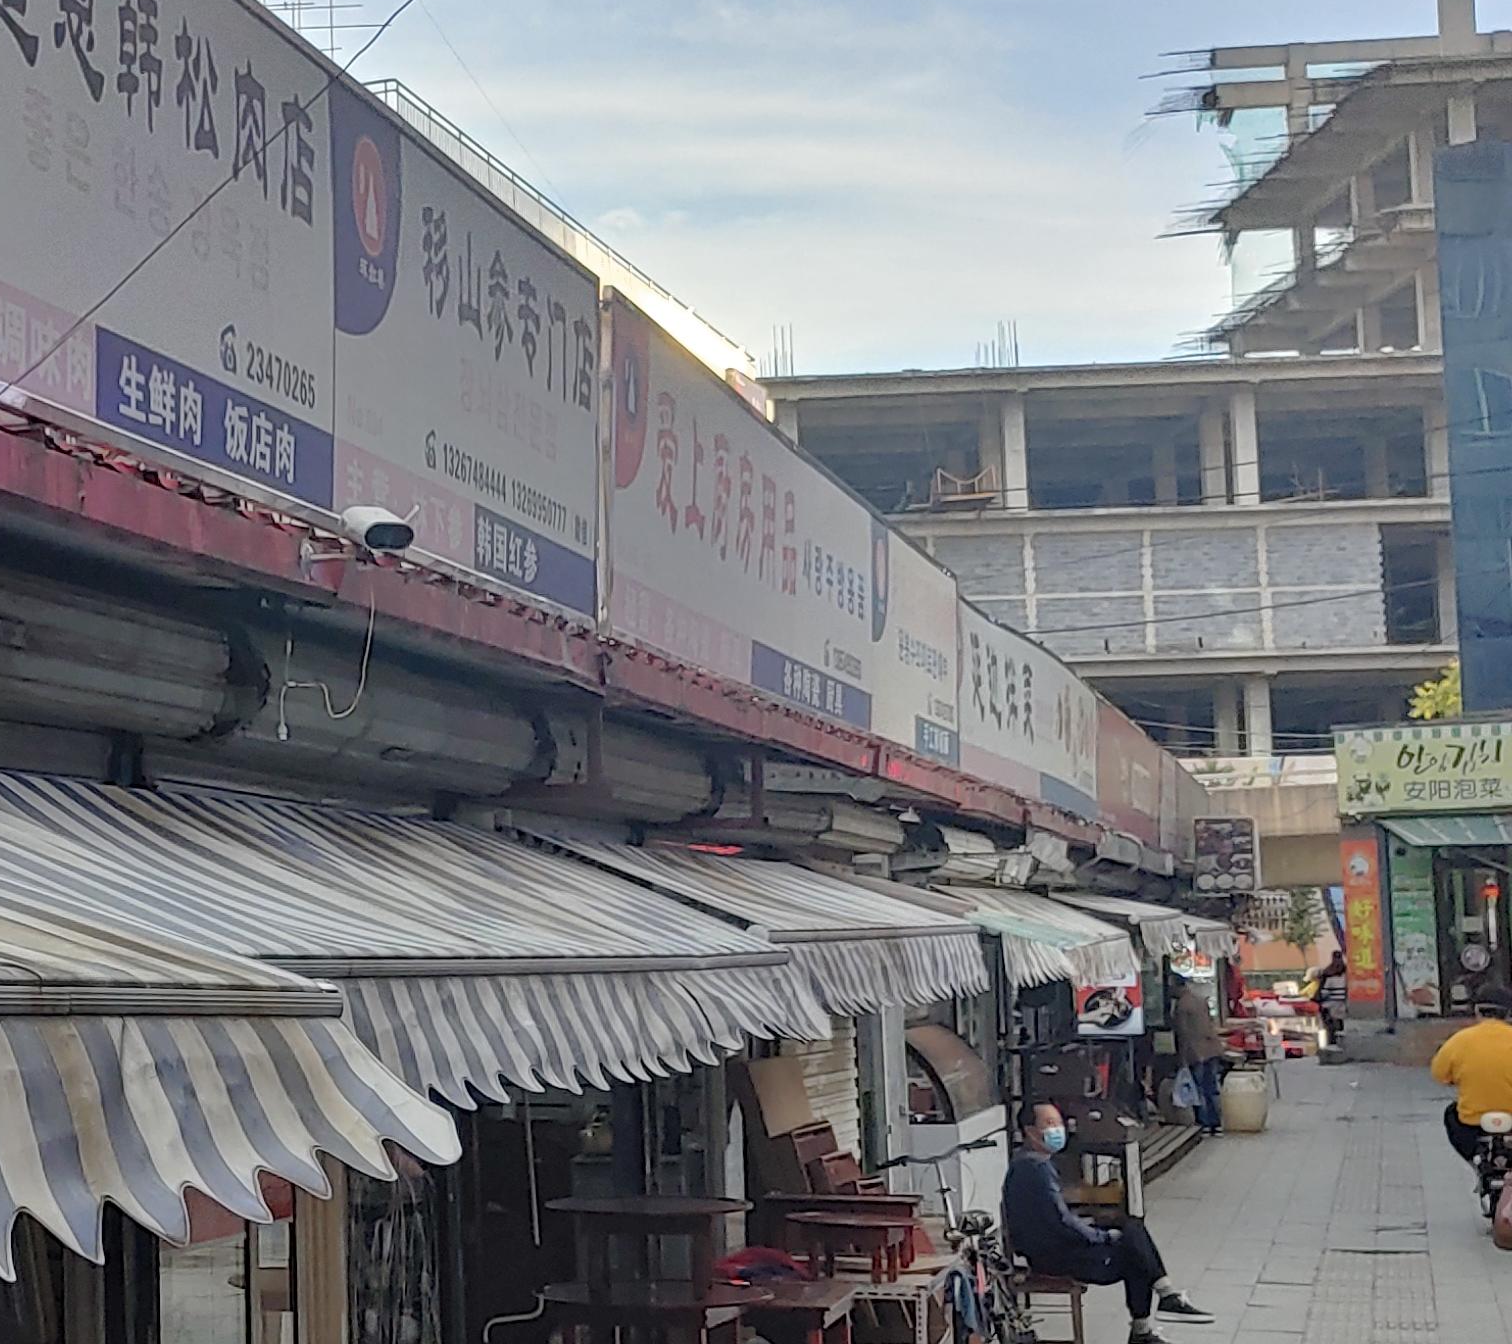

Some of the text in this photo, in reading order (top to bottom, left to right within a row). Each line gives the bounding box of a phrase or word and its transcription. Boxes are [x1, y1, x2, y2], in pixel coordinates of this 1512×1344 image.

[245, 340, 317, 410] 23470265
[118, 354, 203, 447] 生鲜肉
[223, 398, 296, 483] 饭店肉
[476, 515, 540, 584] 韩国红参
[1403, 777, 1503, 802] 安阳泡菜
